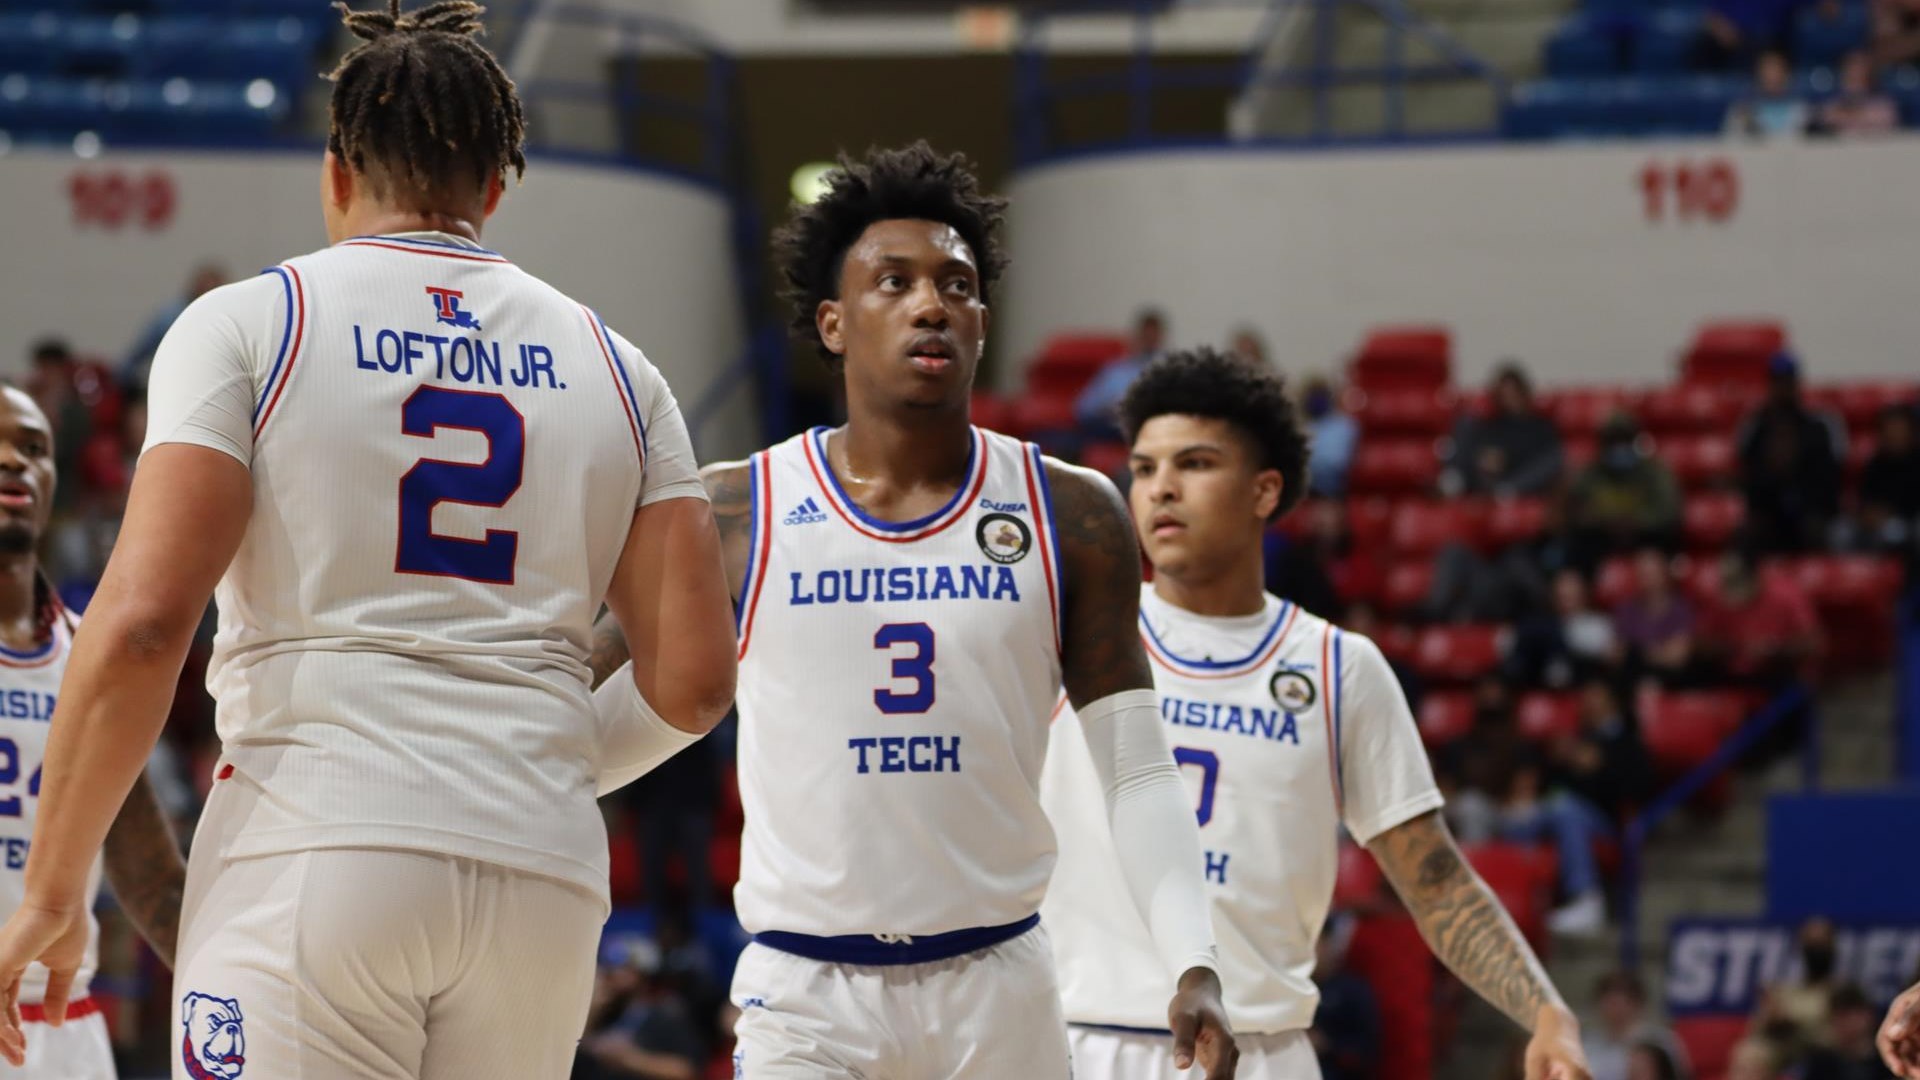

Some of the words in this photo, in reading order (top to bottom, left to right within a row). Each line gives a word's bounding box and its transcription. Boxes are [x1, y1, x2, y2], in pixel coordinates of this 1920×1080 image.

[1638, 158, 1740, 222] 110
[353, 325, 503, 386] LOFTON
[510, 344, 567, 389] JR.
[394, 383, 525, 586] 2
[783, 513, 828, 525] adidas
[790, 565, 1020, 605] LOUISIANA
[873, 622, 935, 714] 3
[848, 736, 961, 774] TECH
